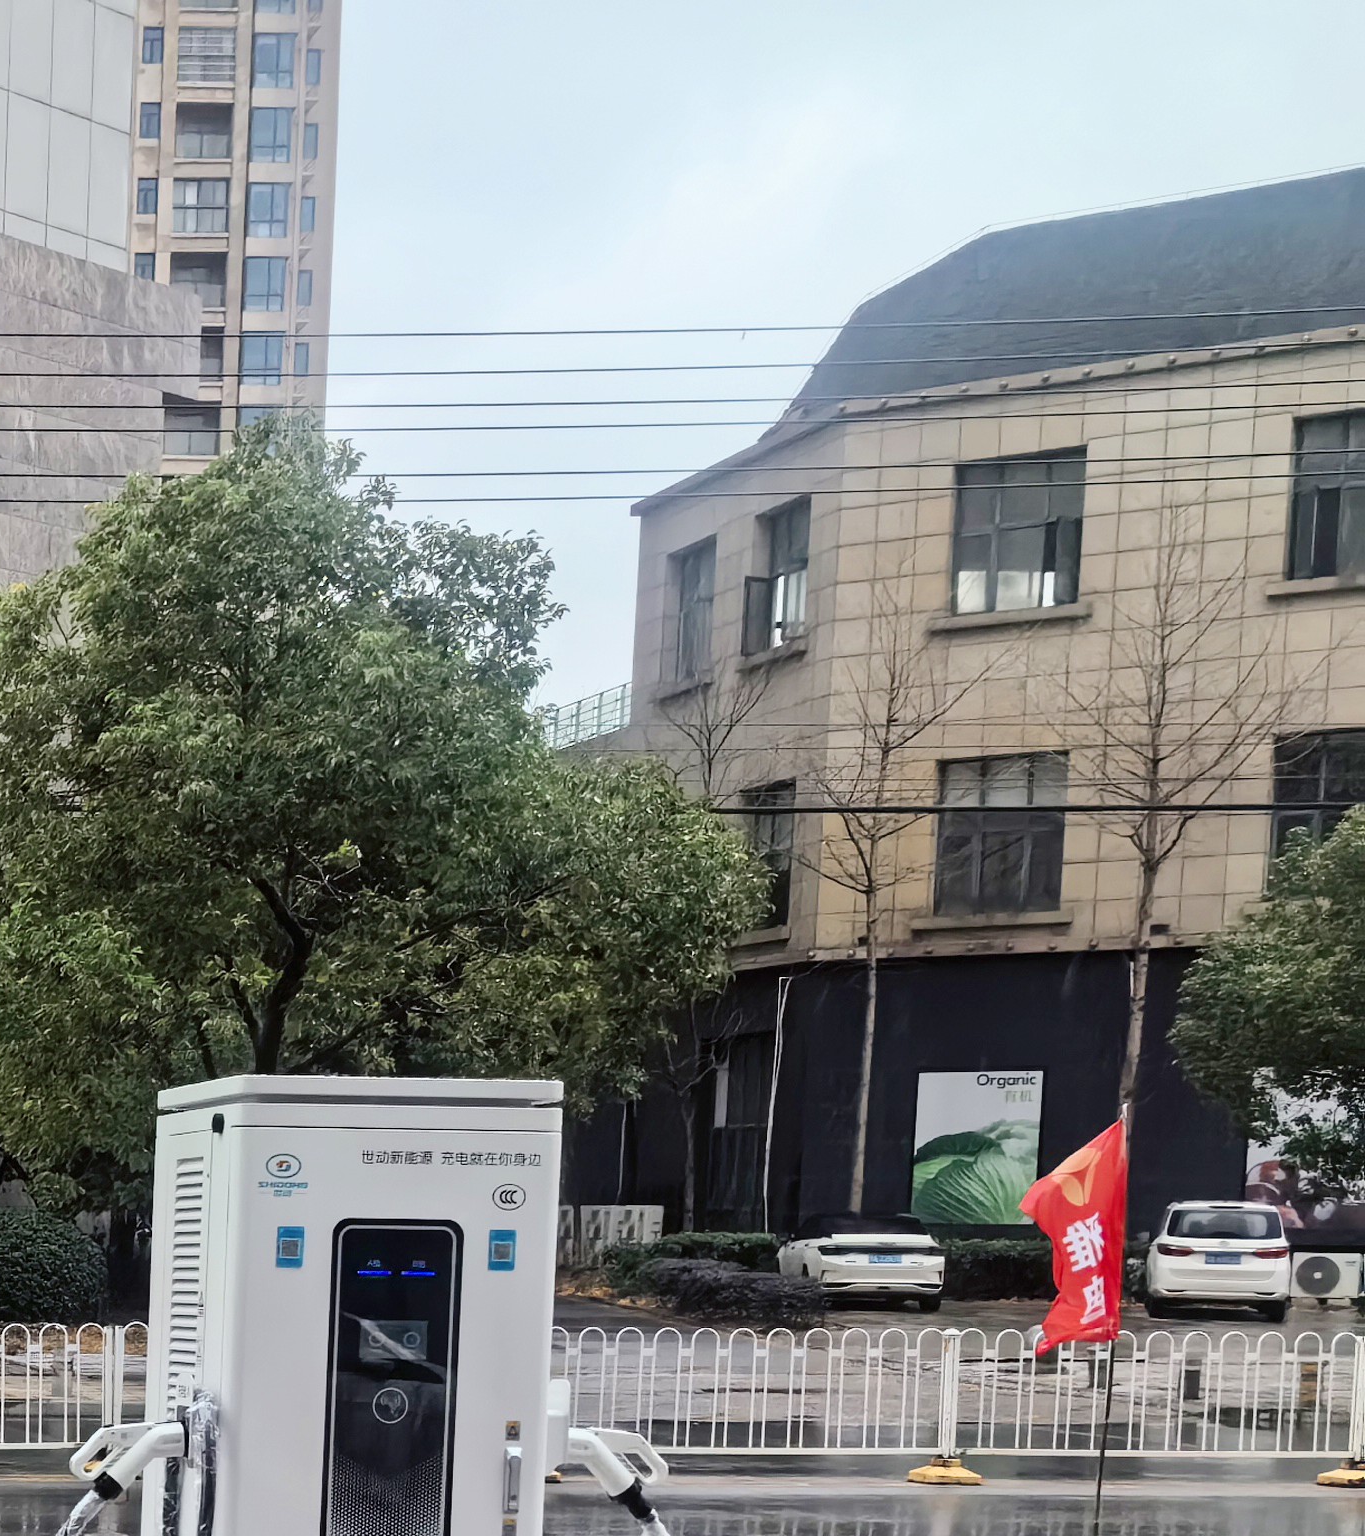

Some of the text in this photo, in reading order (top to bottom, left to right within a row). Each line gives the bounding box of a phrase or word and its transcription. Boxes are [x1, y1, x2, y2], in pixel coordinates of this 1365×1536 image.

[976, 1072, 1037, 1089] Organic
[361, 1150, 542, 1167] 世动新能源 充电就在你身边
